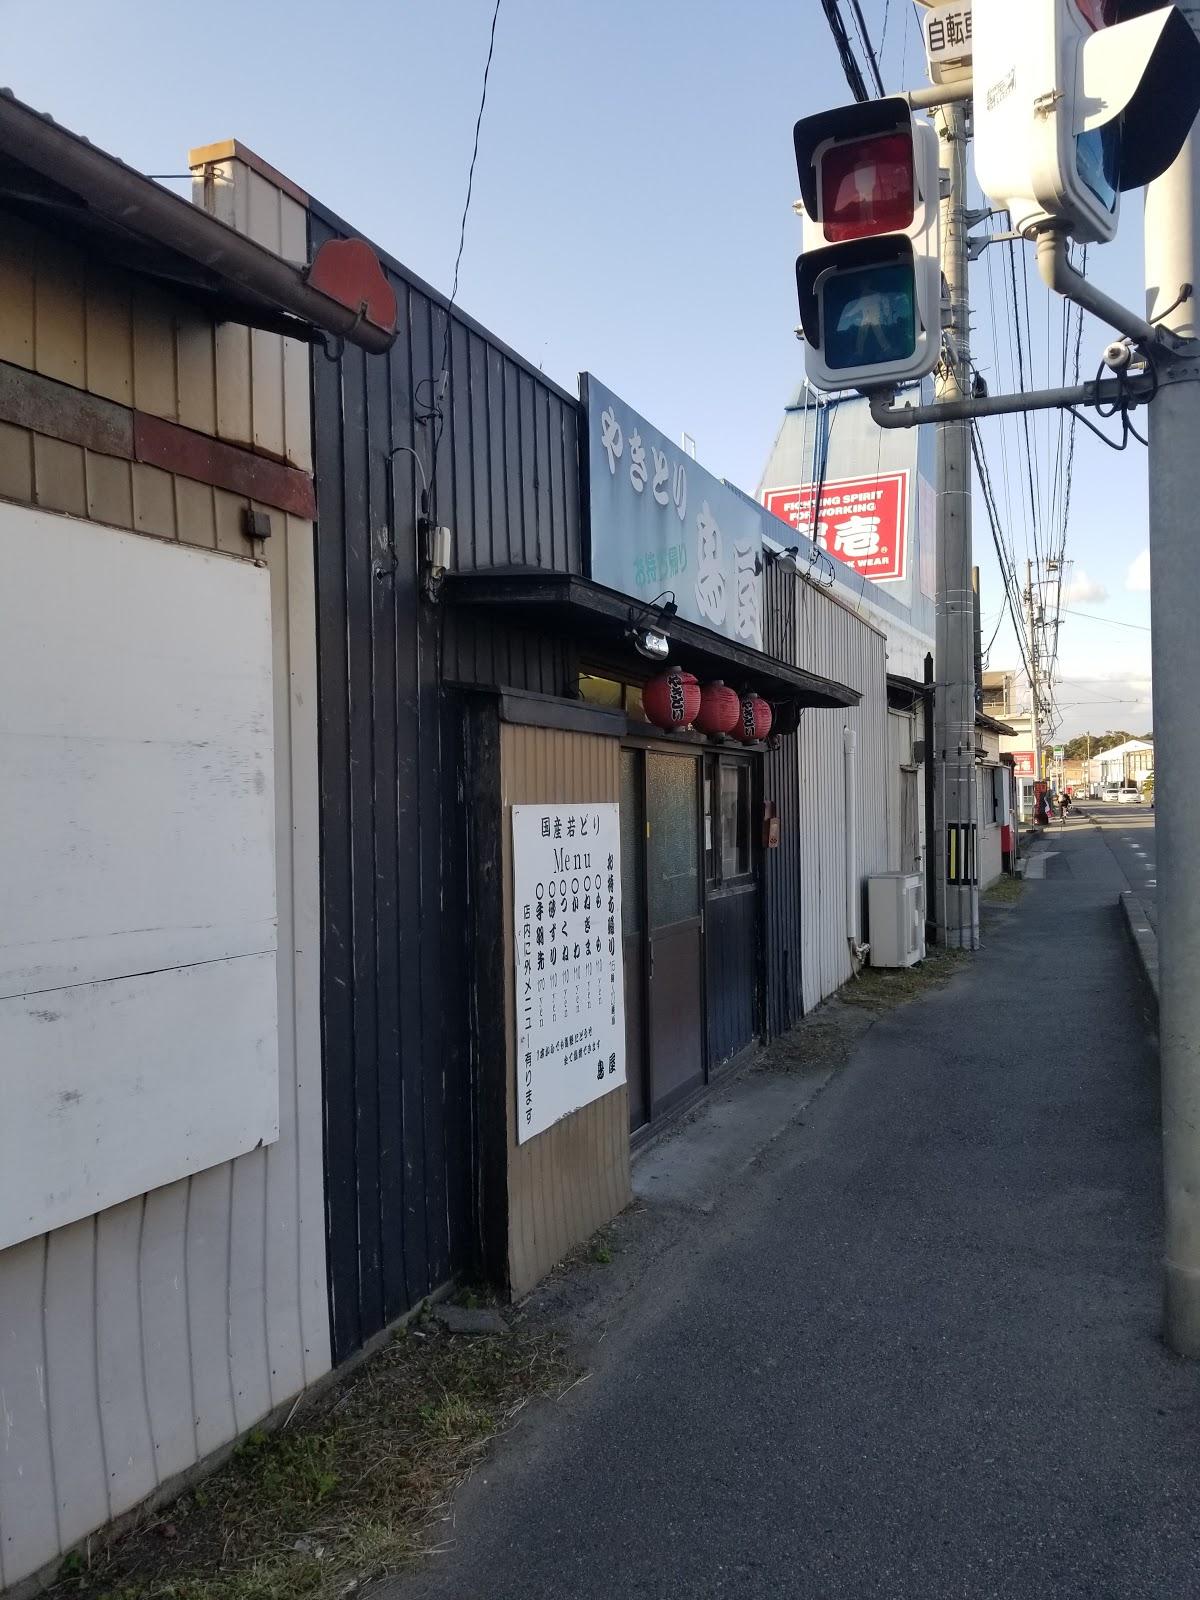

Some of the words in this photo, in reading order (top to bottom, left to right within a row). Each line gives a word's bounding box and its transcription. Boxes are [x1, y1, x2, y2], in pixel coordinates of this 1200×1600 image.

[600, 405, 687, 521] やきとり
[789, 510, 813, 522] FOR
[817, 502, 876, 518] WORKING
[842, 490, 884, 504] SPIRIT
[857, 556, 889, 568] WEAR
[667, 673, 685, 722] やきとり
[541, 813, 600, 840] 国産若どり
[553, 847, 592, 874] Menu
[560, 897, 570, 963] つくね
[572, 895, 581, 960] かわ
[583, 893, 592, 957] ねぎま
[607, 852, 616, 957] お持ち帰り
[535, 901, 546, 971] 手羽先
[523, 903, 533, 1126] 店内に外メニュー有ります
[596, 1052, 616, 1081] 鳥屋
